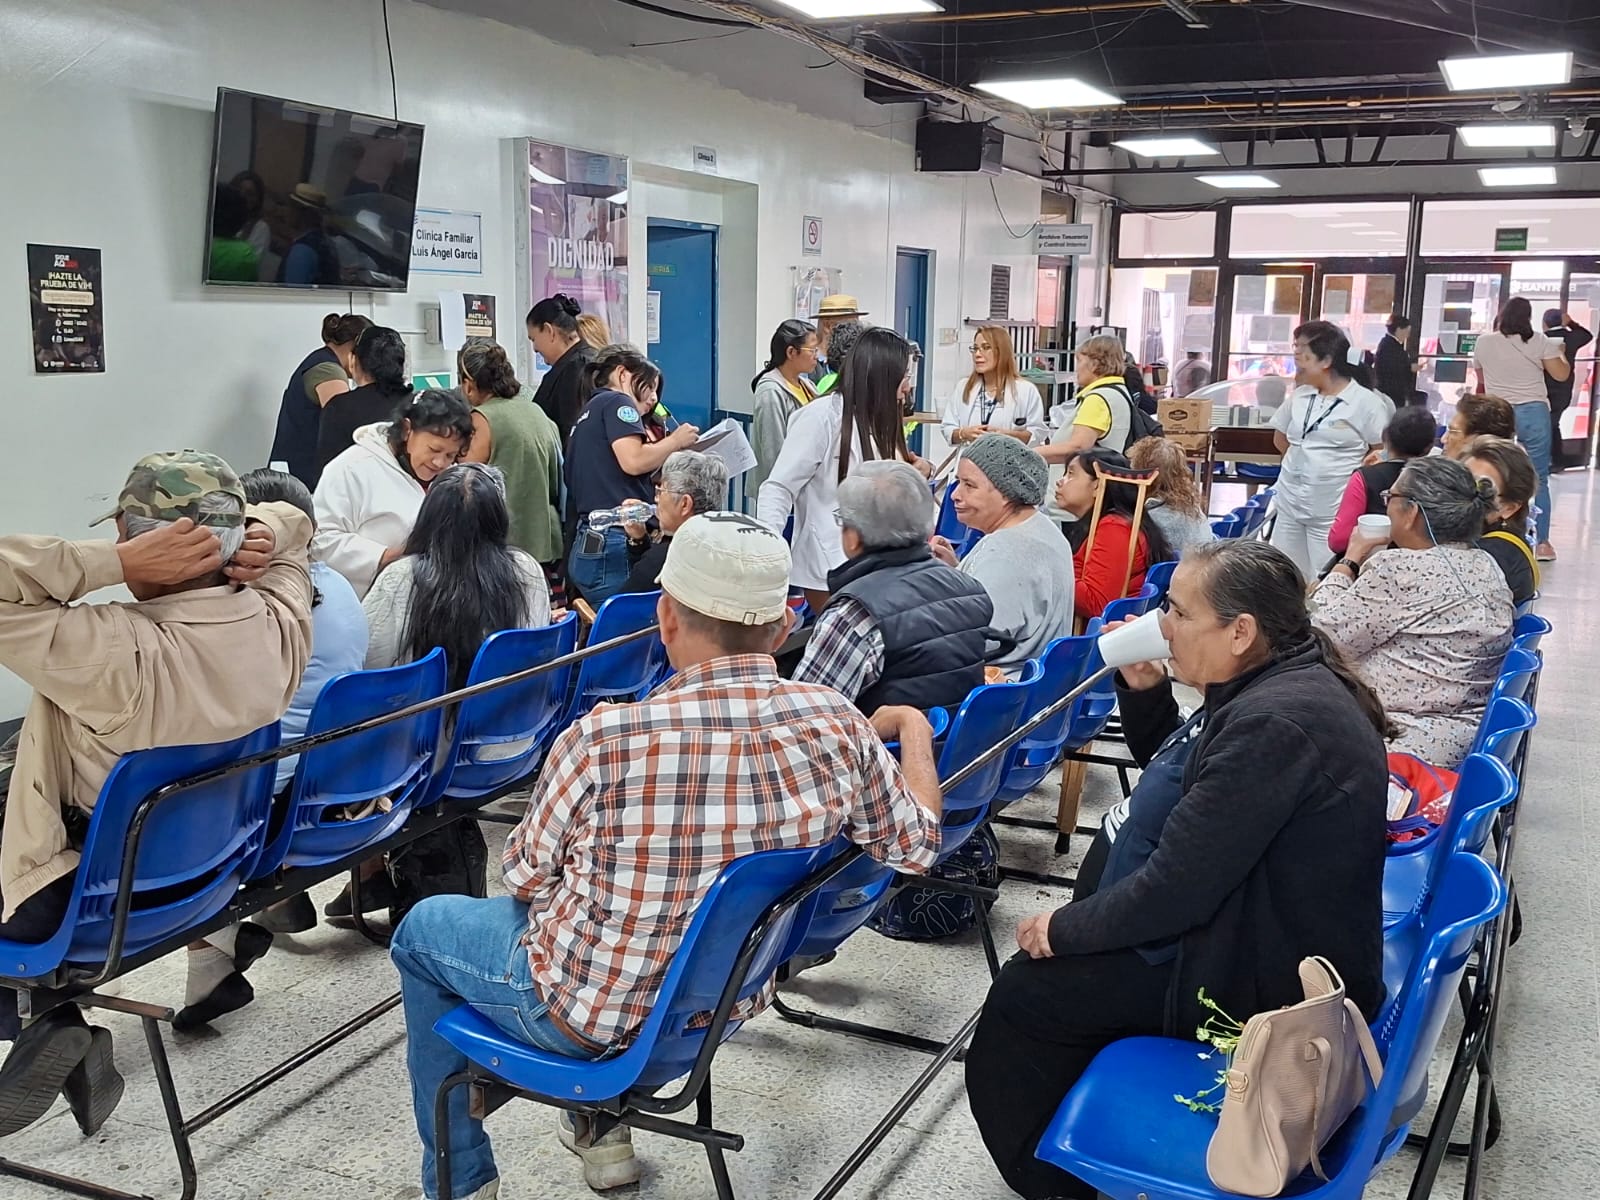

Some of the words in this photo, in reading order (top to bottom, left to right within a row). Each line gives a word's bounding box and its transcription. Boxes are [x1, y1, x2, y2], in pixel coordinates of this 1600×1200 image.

[444, 231, 474, 244] Familiar
[412, 245, 429, 257] Luis
[430, 243, 453, 261] Ángel
[547, 237, 615, 272] DIGNIDAD
[73, 272, 83, 281] LA
[40, 279, 67, 288] PRUEBA
[68, 281, 77, 289] DE
